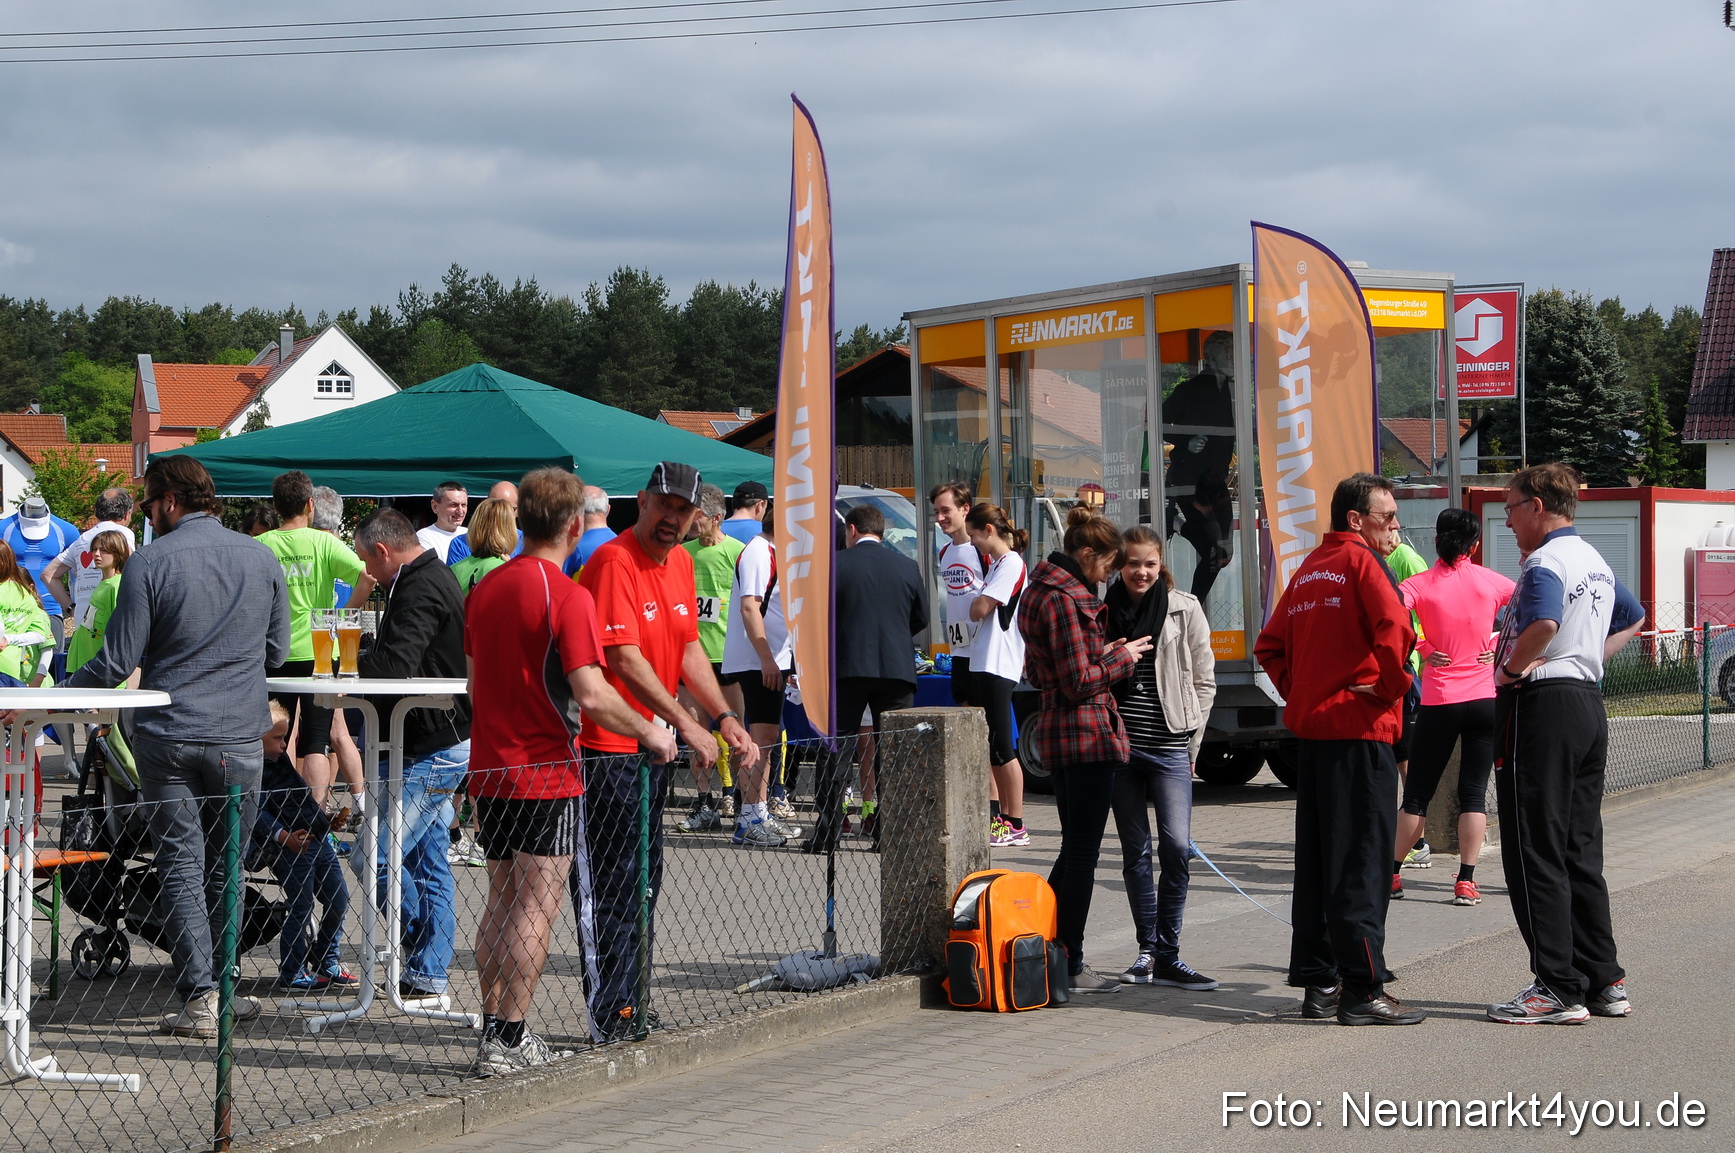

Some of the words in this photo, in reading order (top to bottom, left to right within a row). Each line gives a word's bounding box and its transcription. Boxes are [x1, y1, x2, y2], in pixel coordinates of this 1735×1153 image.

[1370, 299, 1402, 308] Regensburger
[1011, 310, 1134, 344] RUNMARKT.DE
[1456, 362, 1510, 372] EININGER
[1104, 464, 1134, 476] DEINEN
[1569, 577, 1588, 604] ASV
[949, 623, 963, 645] 24
[1213, 646, 1232, 654] analyse
